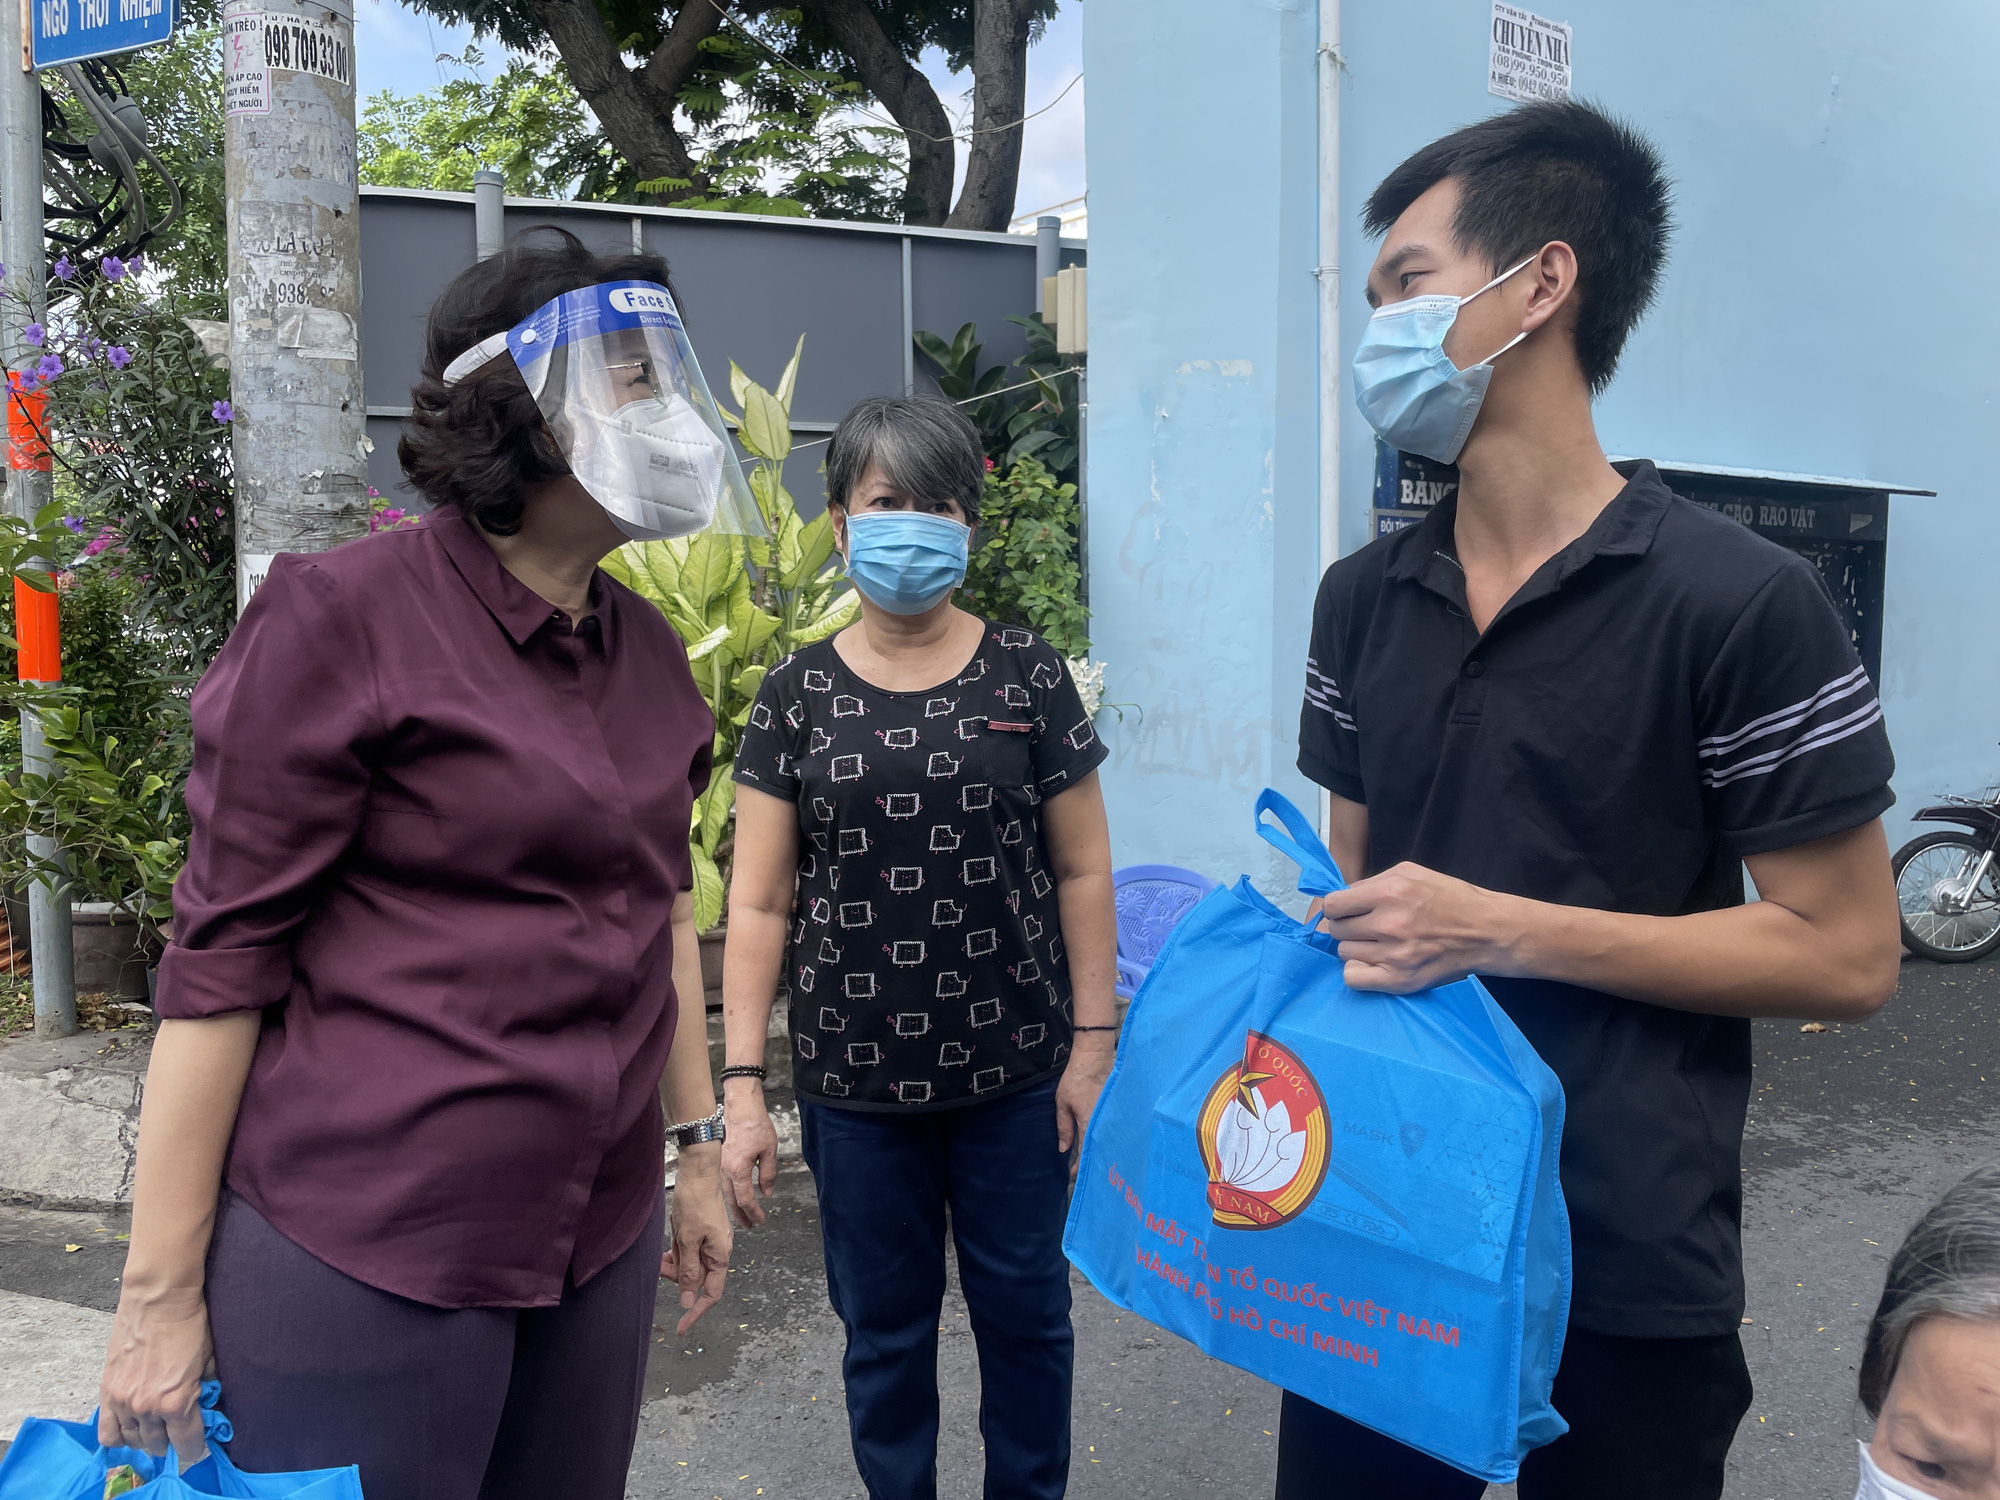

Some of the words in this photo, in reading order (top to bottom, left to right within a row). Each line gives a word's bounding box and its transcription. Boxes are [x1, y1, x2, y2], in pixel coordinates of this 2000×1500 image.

[1495, 4, 1505, 14] CTY
[1545, 31, 1570, 66] NHÀ
[236, 71, 244, 82] ÁP
[246, 72, 263, 81] CAO
[1493, 52, 1568, 87] (08)99.950.950
[239, 82, 260, 95] HIỂM
[238, 98, 263, 109] NGƯỜI
[623, 291, 664, 309] Face
[640, 314, 663, 326] Direct
[1380, 518, 1394, 533] ĐỘI
[1722, 498, 1754, 526] CÁO
[1759, 504, 1788, 527] RAO
[1791, 504, 1816, 534] VẶT
[1272, 1057, 1309, 1099] QUỐC
[1342, 1121, 1395, 1147] MASK
[1231, 1197, 1270, 1223] NAM
[1108, 1163, 1125, 1193] ỦY
[1145, 1212, 1189, 1248] MẶT
[1226, 1265, 1258, 1291] TỔ
[1263, 1277, 1332, 1313] QUỐC
[1337, 1292, 1392, 1328] VIỆT
[1397, 1312, 1460, 1348] NAM
[1229, 1304, 1263, 1332] HỒ
[1268, 1319, 1307, 1346] CHÍ
[1312, 1331, 1379, 1368] MINH
